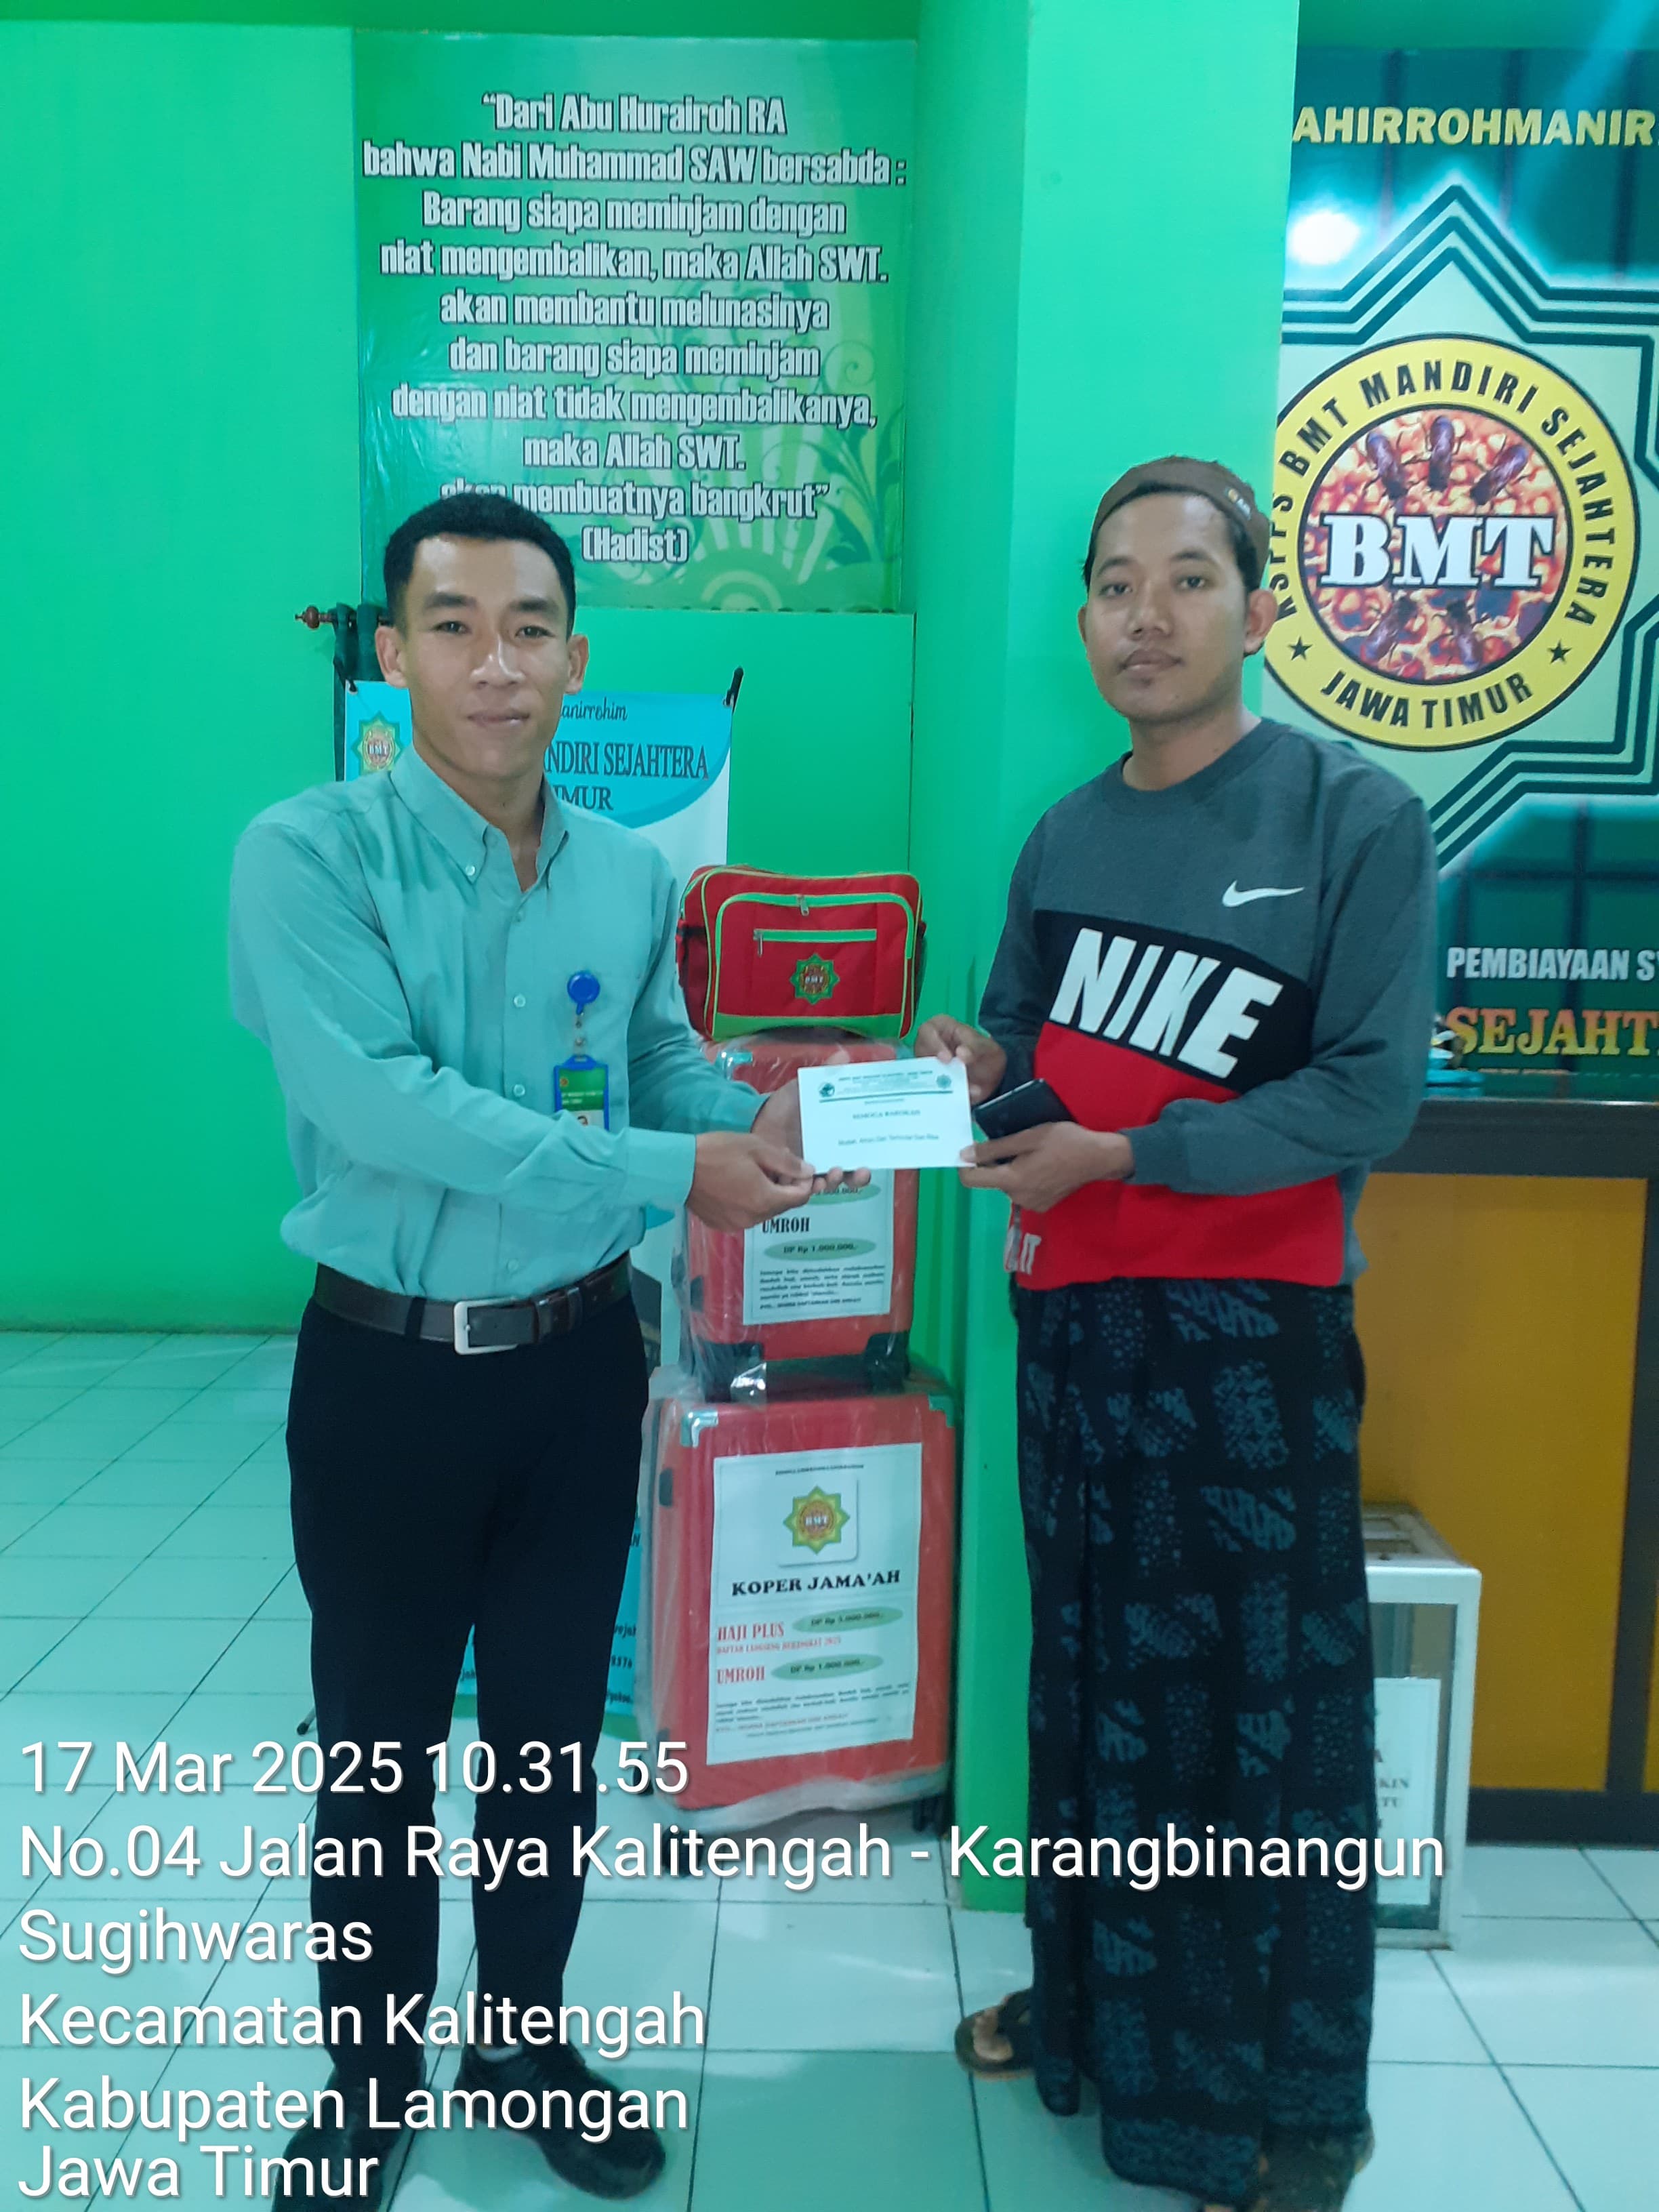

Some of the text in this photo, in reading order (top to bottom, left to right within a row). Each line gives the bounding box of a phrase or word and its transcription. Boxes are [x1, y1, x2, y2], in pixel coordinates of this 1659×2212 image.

[560, 94, 613, 132] Abu
[619, 94, 741, 134] Hurairoh
[747, 96, 787, 135] RA
[1292, 106, 1659, 146] AHIRROHMANIR
[362, 140, 455, 179] bahwa
[461, 141, 522, 180] Nabi
[527, 142, 684, 182] Muhammad
[689, 145, 756, 184] SAW
[761, 147, 891, 186] bersabda
[422, 189, 846, 240] Barang siapa meminjam dengan
[380, 239, 889, 283] niat mengembalikan, maka Allah SWT.
[440, 288, 829, 331] akan membantu melunasinya
[449, 336, 820, 382] dan barang siapa meminjam
[392, 383, 878, 430] dengan niat tidak mengembalikanya,
[523, 432, 747, 470] maka Allah SWT.
[512, 482, 684, 521] membuatnya
[1279, 359, 1616, 628] BMT MANDIRI SEJAHTERA
[581, 526, 689, 565] (Hadist)
[1318, 512, 1556, 588] BMT
[561, 697, 628, 721] anirrohim
[1320, 670, 1533, 729] JAWA TIMUR
[546, 741, 710, 780] NDIRI SEJAHTERA
[1446, 947, 1659, 981] PEMBIAYAAN S
[1048, 927, 1284, 1080] NIKE
[1446, 1006, 1659, 1057] SEJAHT
[762, 1217, 811, 1234] UMROH
[732, 1570, 901, 1597] KOPER JAMA'AH
[717, 1624, 747, 1642] HAJI
[752, 1622, 785, 1639] PLUS
[716, 1666, 766, 1684] UMROH
